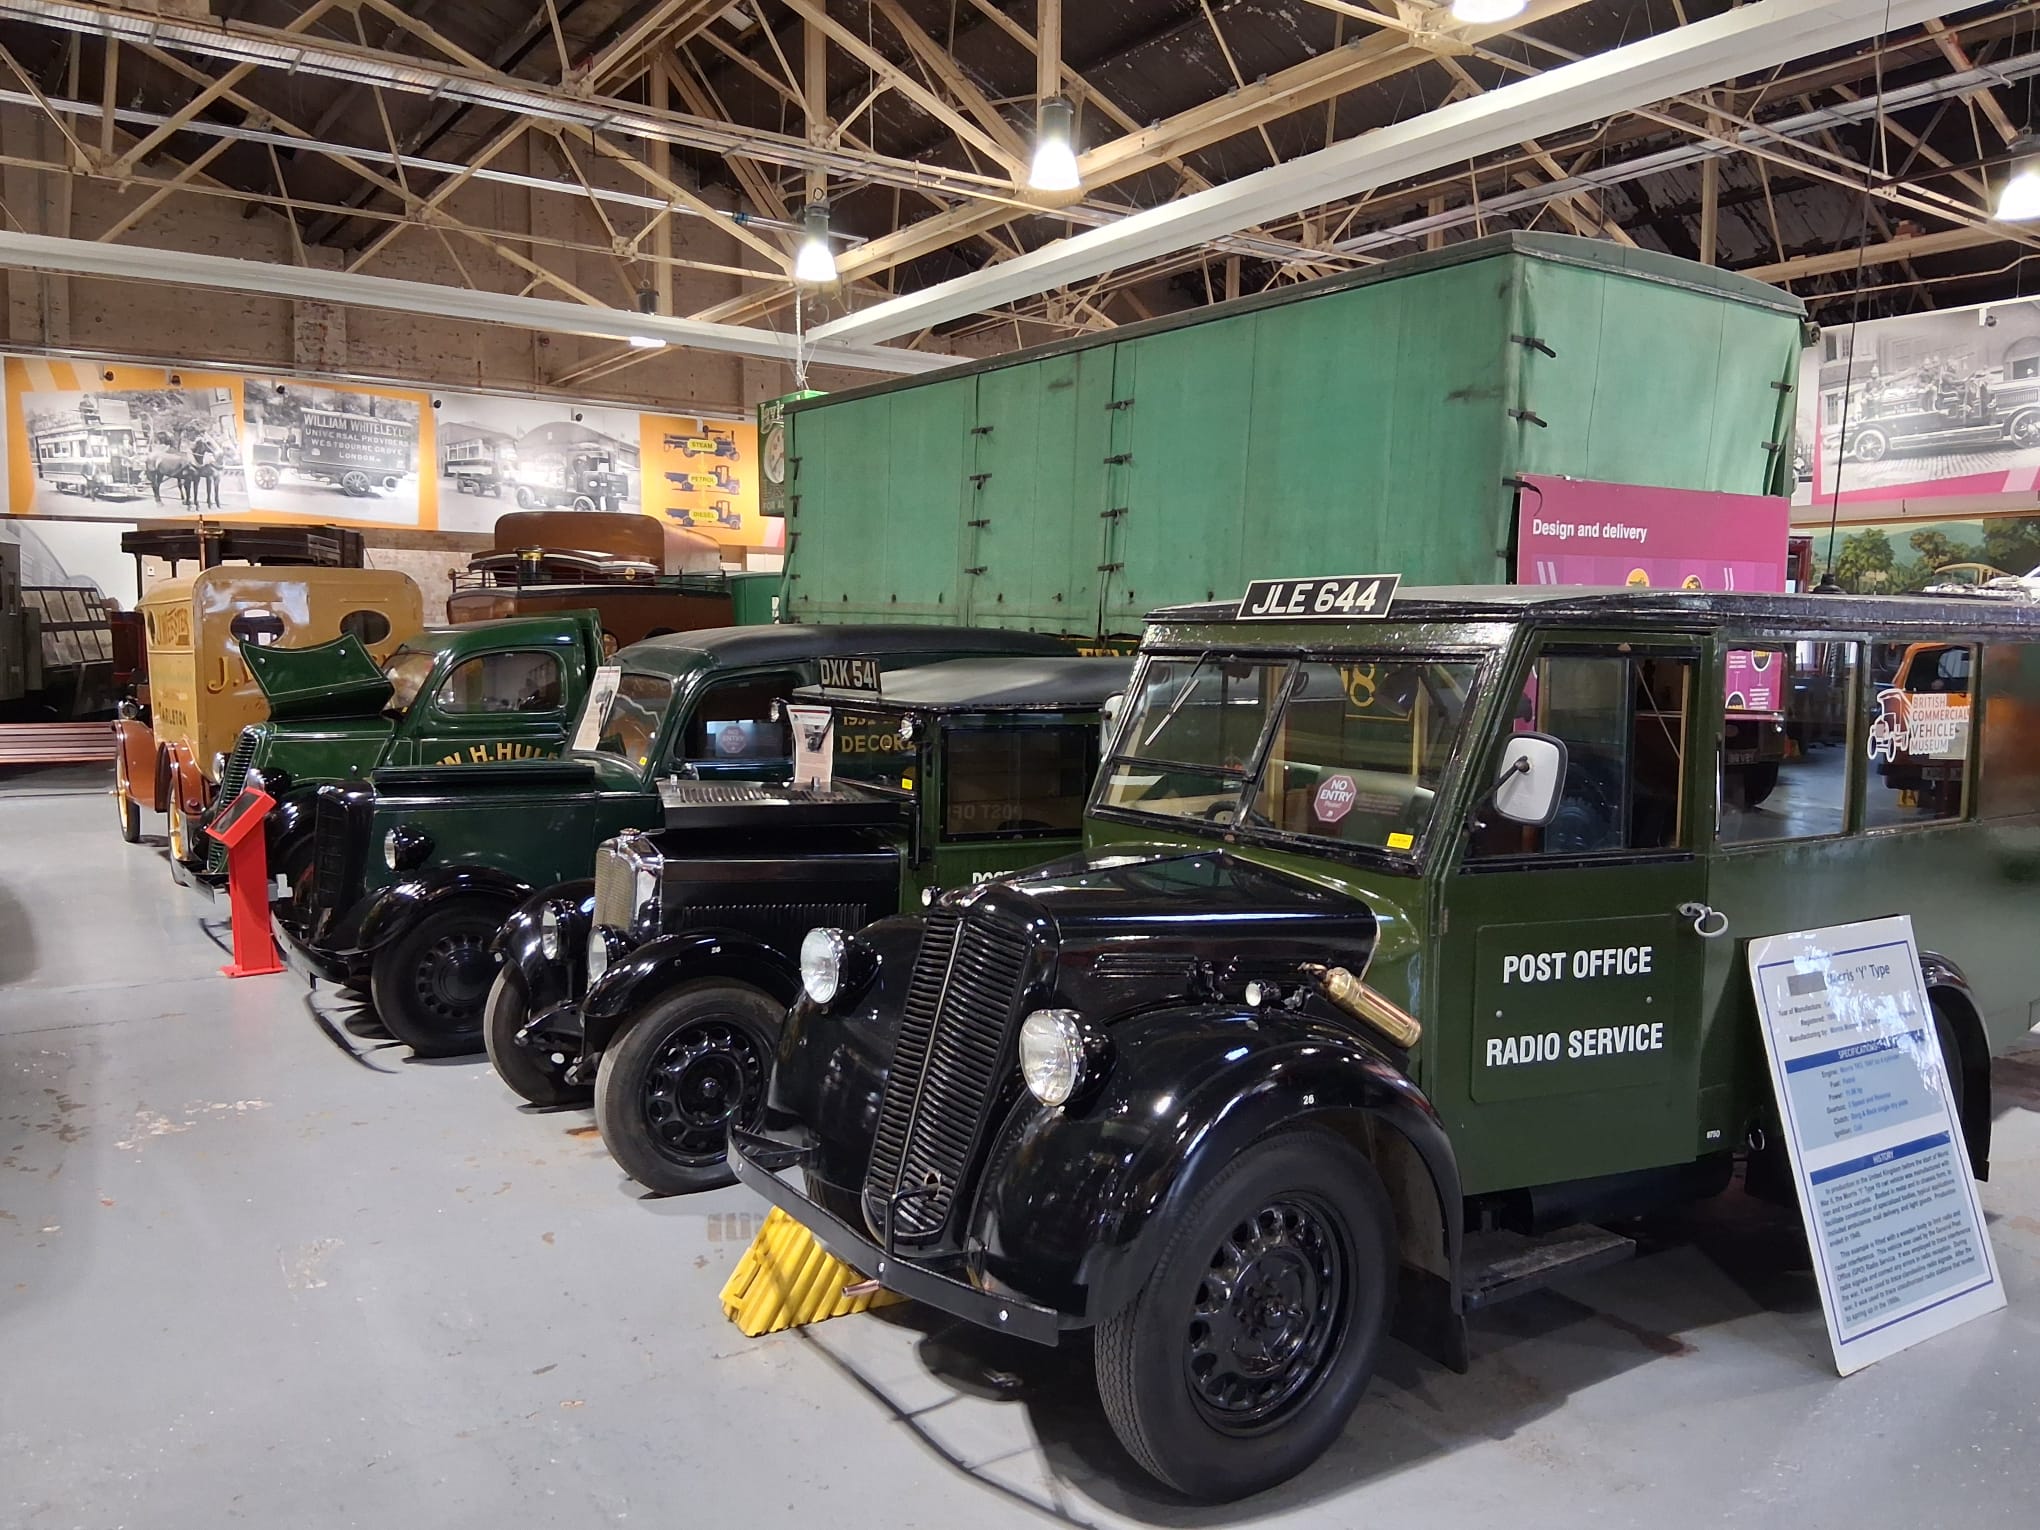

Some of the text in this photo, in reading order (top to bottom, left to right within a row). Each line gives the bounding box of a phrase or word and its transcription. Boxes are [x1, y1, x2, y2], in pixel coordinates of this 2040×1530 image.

[303, 413, 347, 430] WILLIAM
[305, 428, 358, 441] UNIVERSAL
[311, 438, 402, 456] WESTBOURNE GROVE
[691, 440, 714, 449] STEAM
[691, 475, 714, 483] PETROL
[693, 511, 715, 519] DIESEL
[1533, 518, 1647, 543] Design and delivery
[1251, 580, 1380, 614] JLE 644
[819, 658, 877, 689] DXK 541
[1913, 696, 1945, 708] BRITISH
[1912, 709, 1968, 721] COMMERCIAL
[1912, 723, 1954, 738] VEHICLE
[1911, 738, 1947, 751] MUSEUM
[1331, 779, 1348, 790] NO
[1320, 789, 1353, 802] ENTRY
[1503, 945, 1652, 983] POST OFFICE
[1868, 962, 1890, 978] Type
[1486, 1022, 1663, 1067] RADIO SERVICE
[1873, 1150, 1893, 1163] HISTORY
